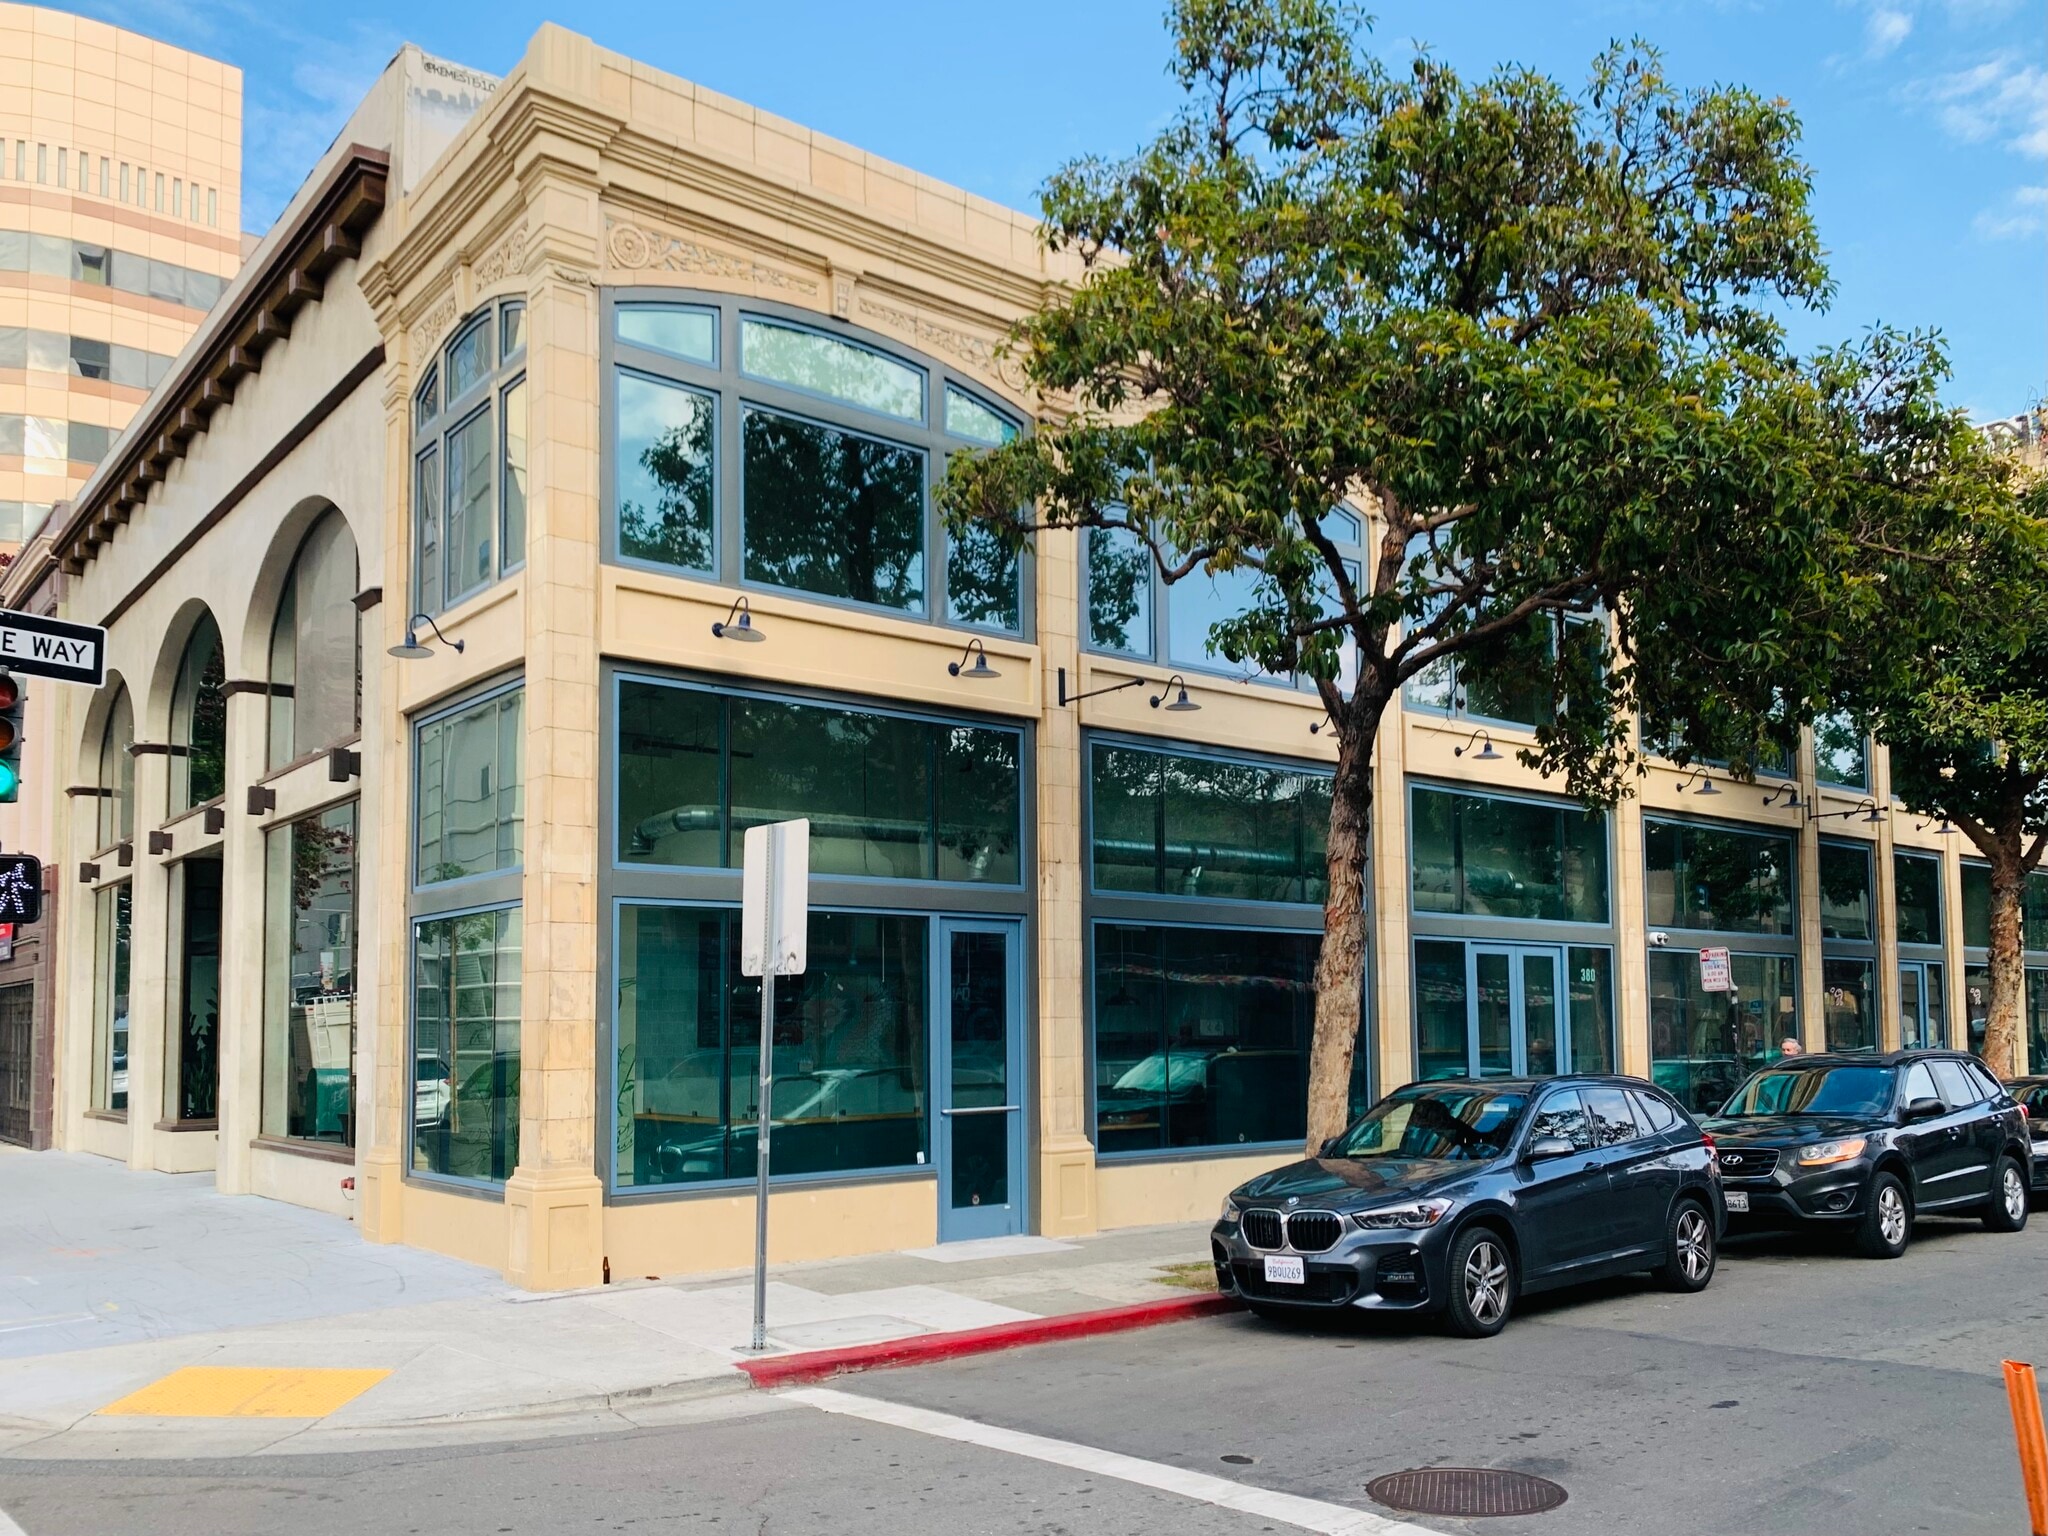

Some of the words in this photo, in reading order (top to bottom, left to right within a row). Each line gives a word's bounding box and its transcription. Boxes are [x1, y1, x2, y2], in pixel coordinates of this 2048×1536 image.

[32, 635, 87, 664] WAY
[1580, 968, 1596, 982] 380
[1267, 1266, 1301, 1280] 9BQU269
